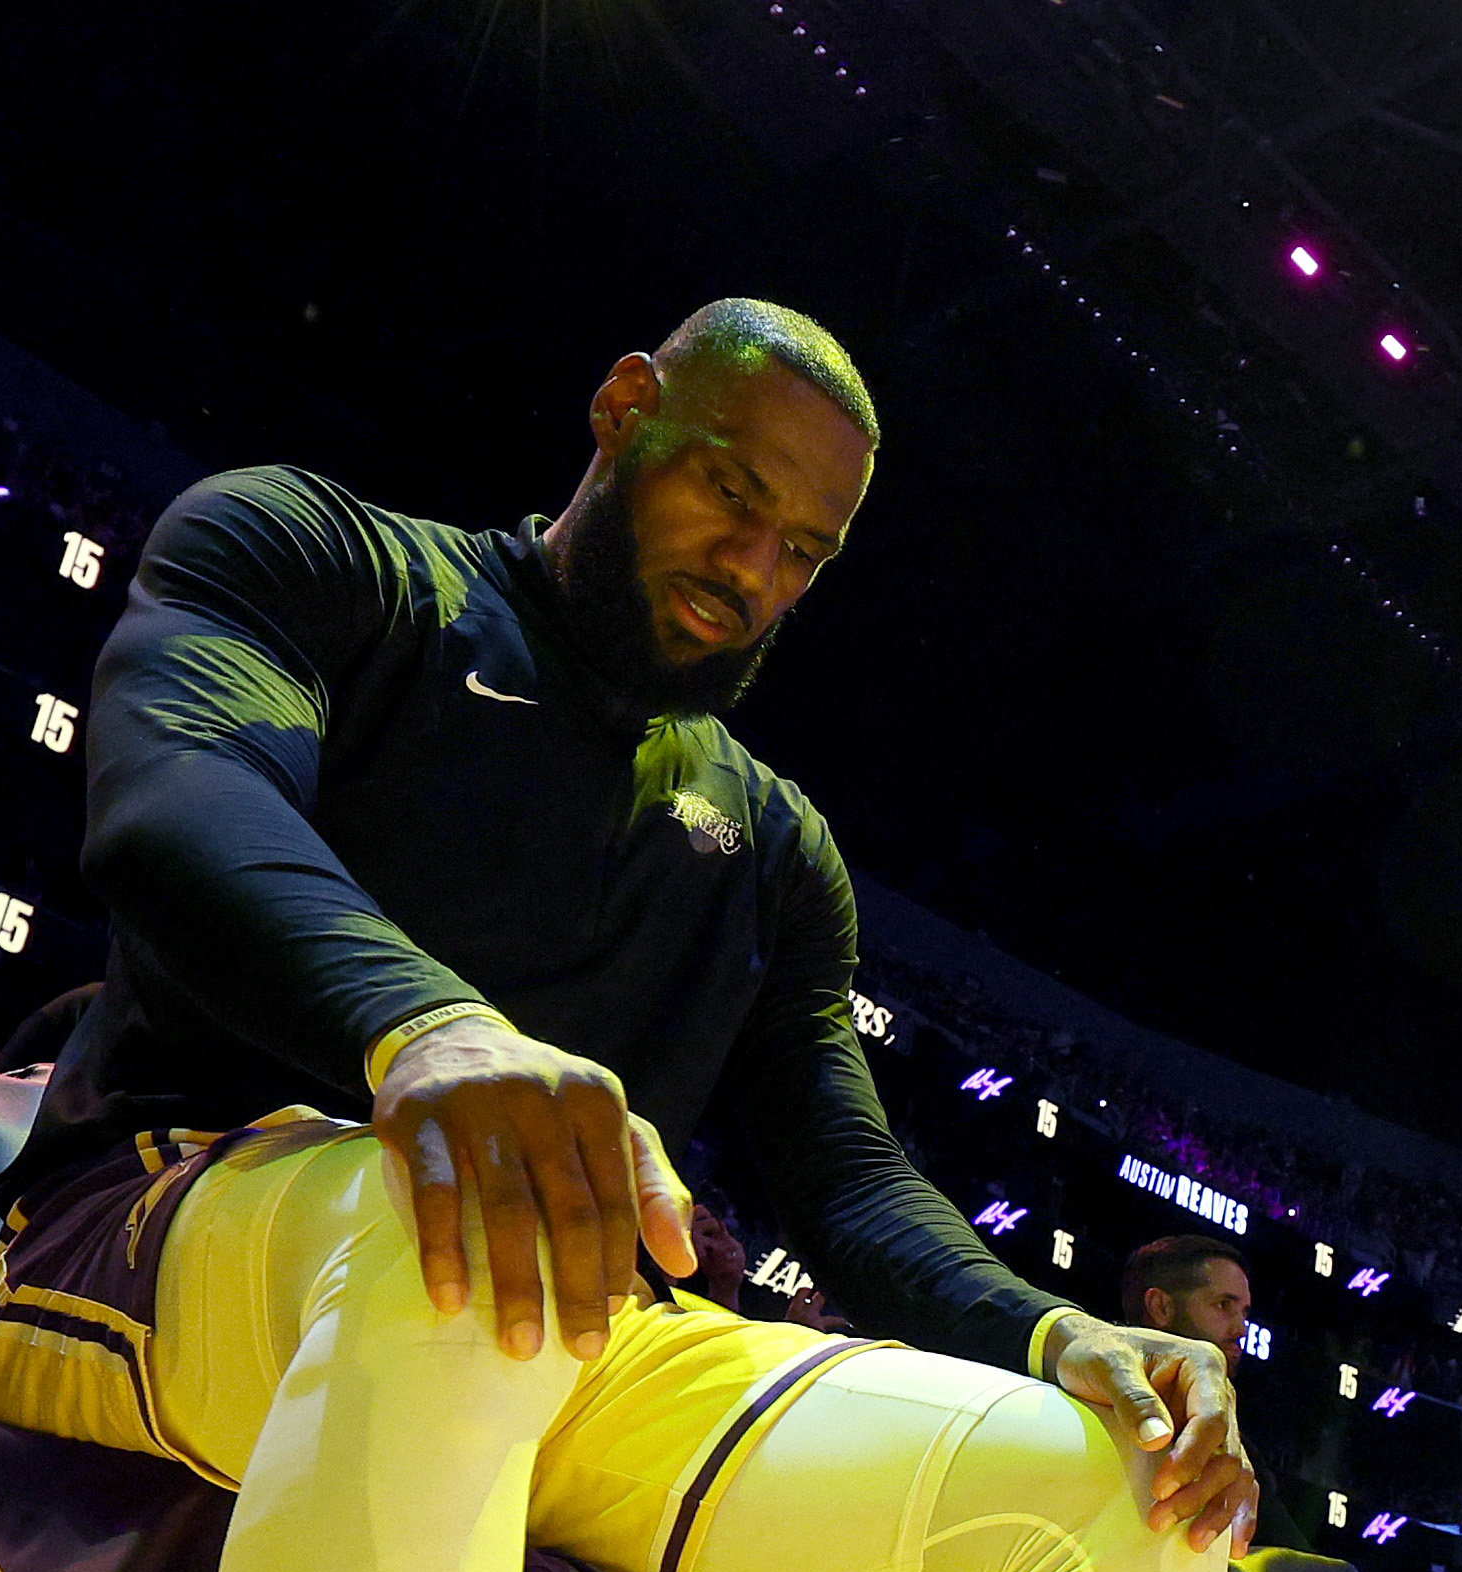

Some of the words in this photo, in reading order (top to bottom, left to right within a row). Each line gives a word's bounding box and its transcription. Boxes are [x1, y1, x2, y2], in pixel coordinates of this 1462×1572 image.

[58, 531, 105, 589] 15
[30, 693, 79, 753] 15
[1036, 1098, 1059, 1139] 15
[1118, 1154, 1175, 1200] AUSTIN
[1175, 1174, 1249, 1235] REAVES
[1052, 1229, 1075, 1270] 15
[1314, 1242, 1334, 1278] 15
[1339, 1363, 1359, 1400] 15
[1328, 1491, 1348, 1529] 15
